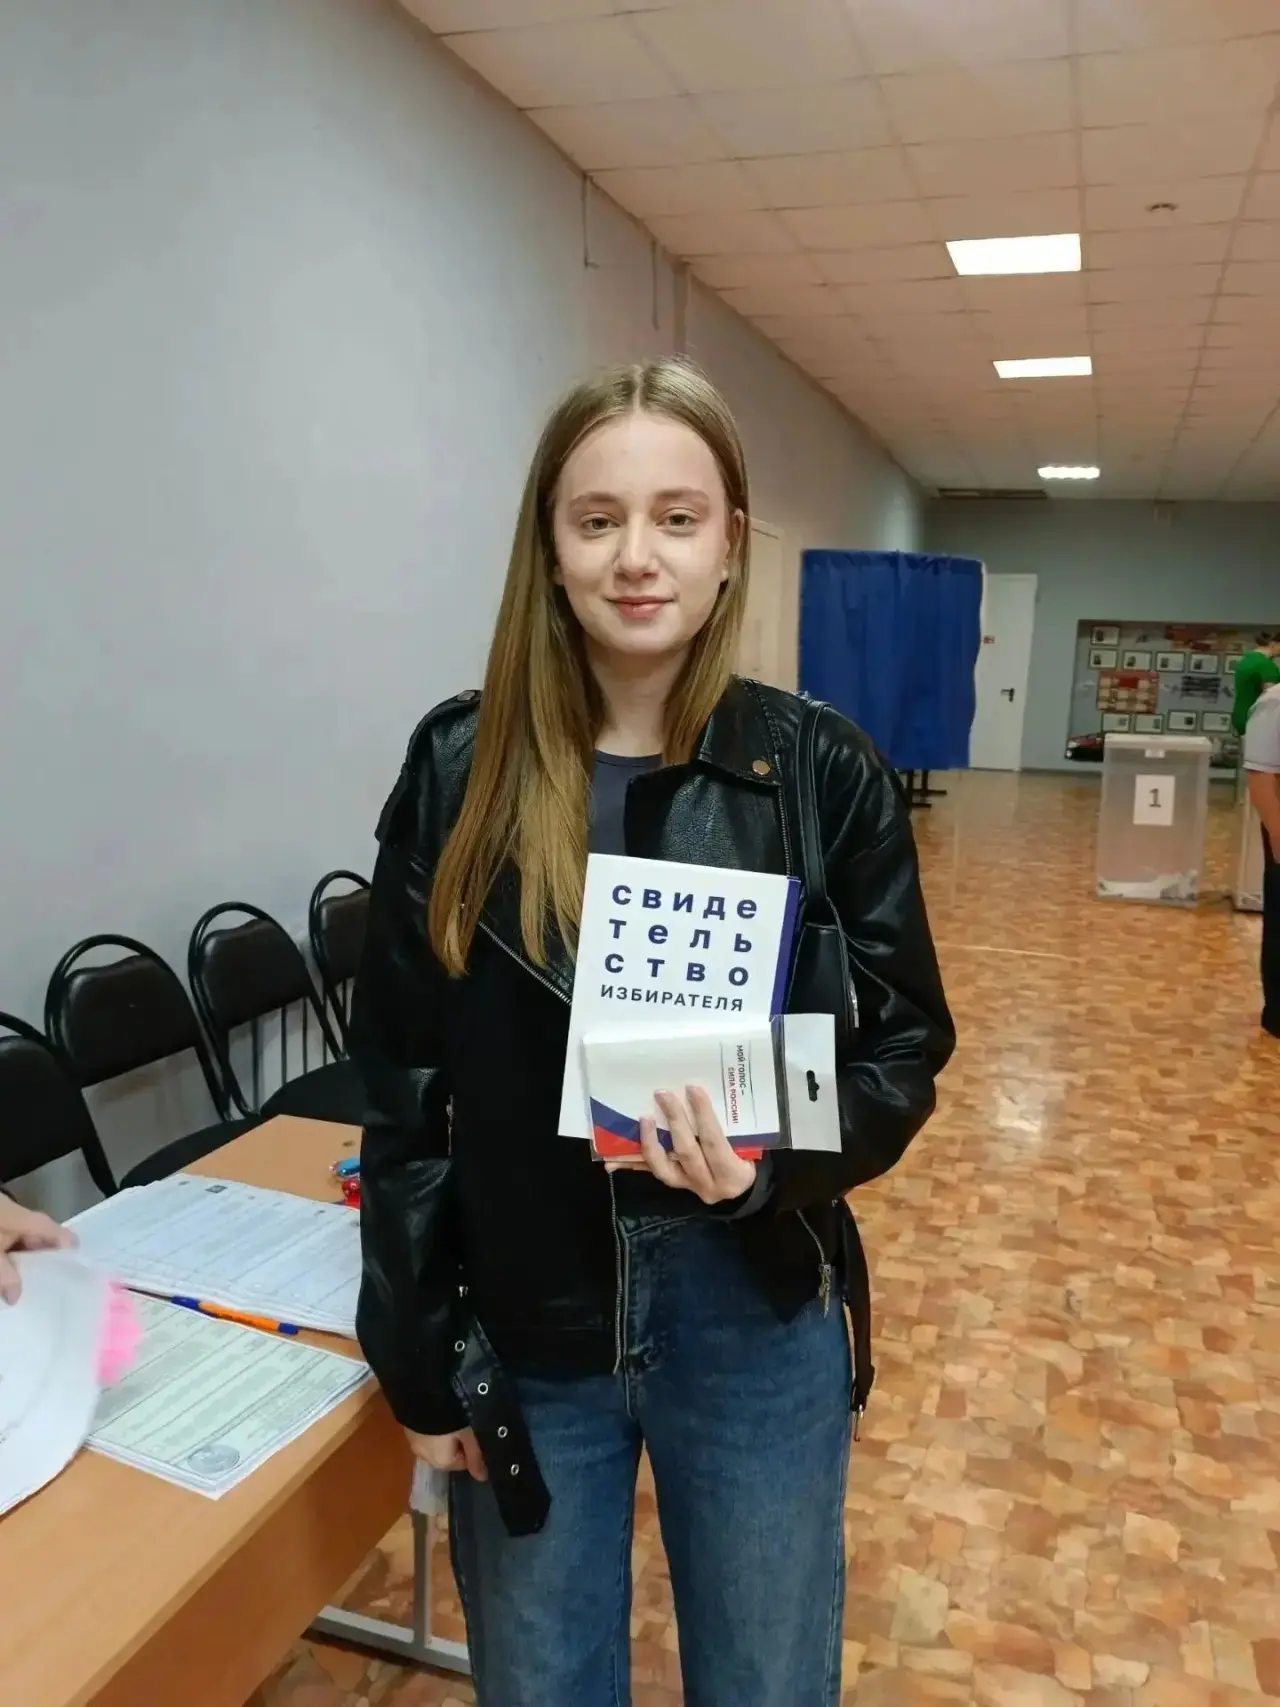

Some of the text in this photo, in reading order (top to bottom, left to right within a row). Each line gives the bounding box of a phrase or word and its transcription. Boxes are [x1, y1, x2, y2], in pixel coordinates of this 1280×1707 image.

[1149, 788, 1162, 808] 1
[612, 884, 757, 920] свиде
[609, 918, 752, 953] тель
[604, 953, 749, 986] ство
[600, 984, 743, 1012] ИЗБИРАТЕЛЯ
[736, 1045, 746, 1062] МОЙ
[737, 1063, 747, 1089] ГОЛОС
[727, 1067, 739, 1124] СИЛА РОССИИ!
